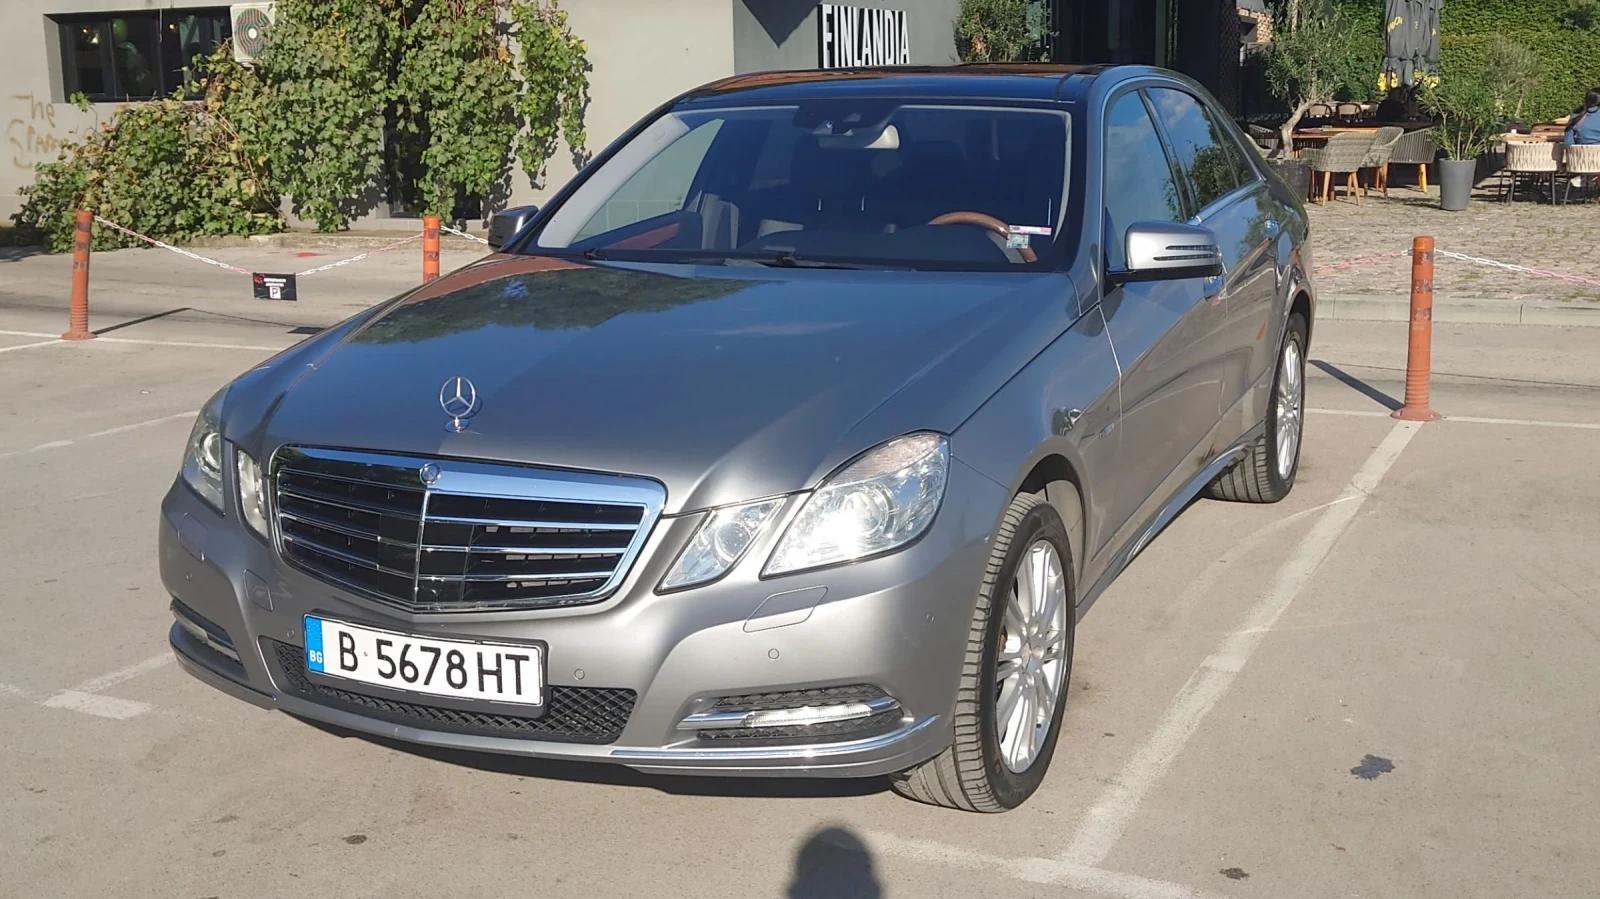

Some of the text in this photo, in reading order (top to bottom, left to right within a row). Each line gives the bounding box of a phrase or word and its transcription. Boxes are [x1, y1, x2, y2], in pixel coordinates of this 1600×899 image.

[820, 4, 910, 69] FINLANDIA
[309, 649, 323, 664] BG
[338, 630, 530, 696] B 5678 HT
